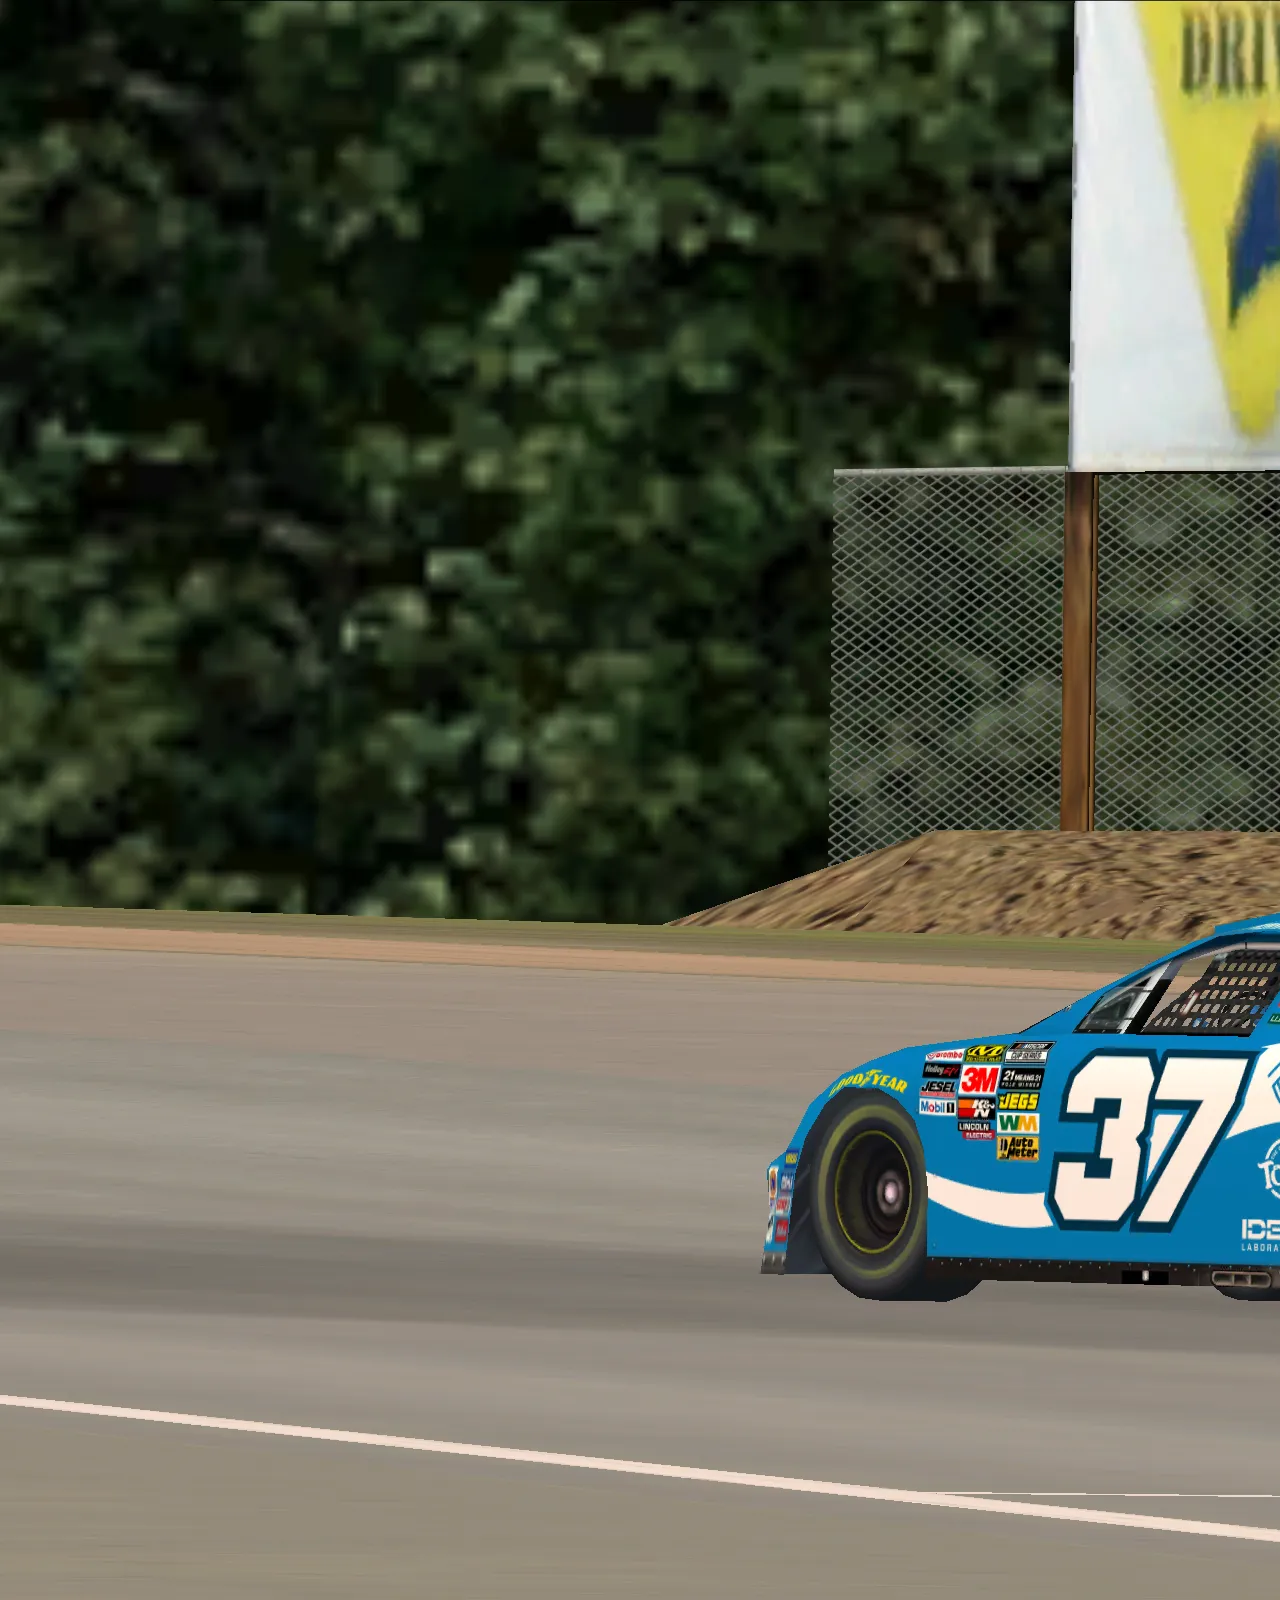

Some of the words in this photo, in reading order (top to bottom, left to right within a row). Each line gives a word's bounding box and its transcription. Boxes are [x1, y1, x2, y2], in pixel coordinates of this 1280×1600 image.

[961, 1067, 999, 1093] 3M
[1003, 1070, 1015, 1081] 21
[828, 1069, 908, 1098] GOODYEAR
[921, 1081, 956, 1092] JESEL
[920, 1100, 945, 1113] Mobil
[1000, 1094, 1039, 1110] JEGS
[959, 1123, 990, 1131] LINCOLN
[1000, 1115, 1038, 1132] WM
[1010, 1138, 1034, 1148] Auto
[1051, 1053, 1255, 1226] 37
[1007, 1147, 1038, 1159] Meter
